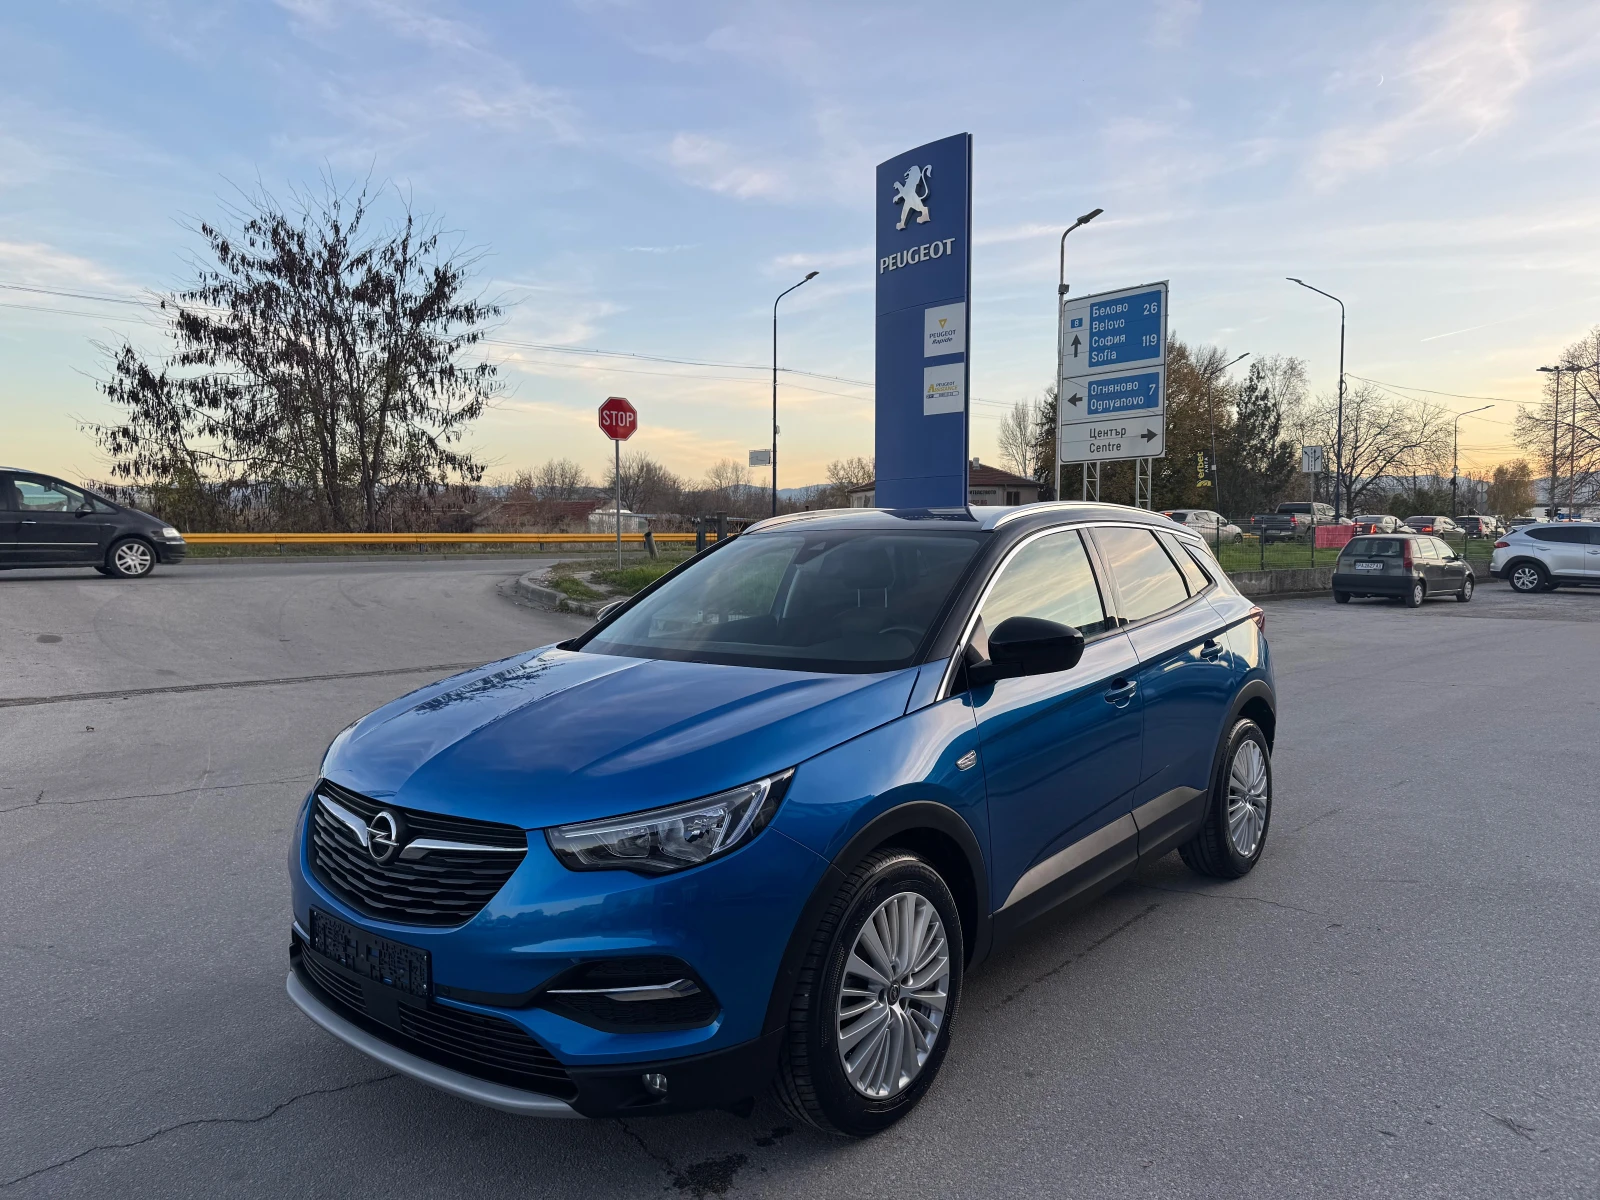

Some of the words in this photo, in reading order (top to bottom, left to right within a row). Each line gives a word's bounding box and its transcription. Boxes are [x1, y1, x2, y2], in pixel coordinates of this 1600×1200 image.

[879, 237, 956, 275] PEUGEOT
[1092, 302, 1129, 317] Белово
[1143, 302, 1158, 316] 26
[1092, 319, 1125, 332] Belovo
[929, 329, 957, 339] PEUGEOT
[1091, 333, 1126, 348] София
[1142, 333, 1158, 347] 119
[1091, 349, 1117, 363] Sofia
[1090, 380, 1139, 395] Огняново
[1148, 384, 1156, 396] 7
[1090, 395, 1144, 412] Ognyanovo
[602, 410, 634, 427] STOP
[1089, 427, 1127, 441] Център
[1089, 441, 1122, 454] Centre
[1196, 451, 1205, 479] efbet
